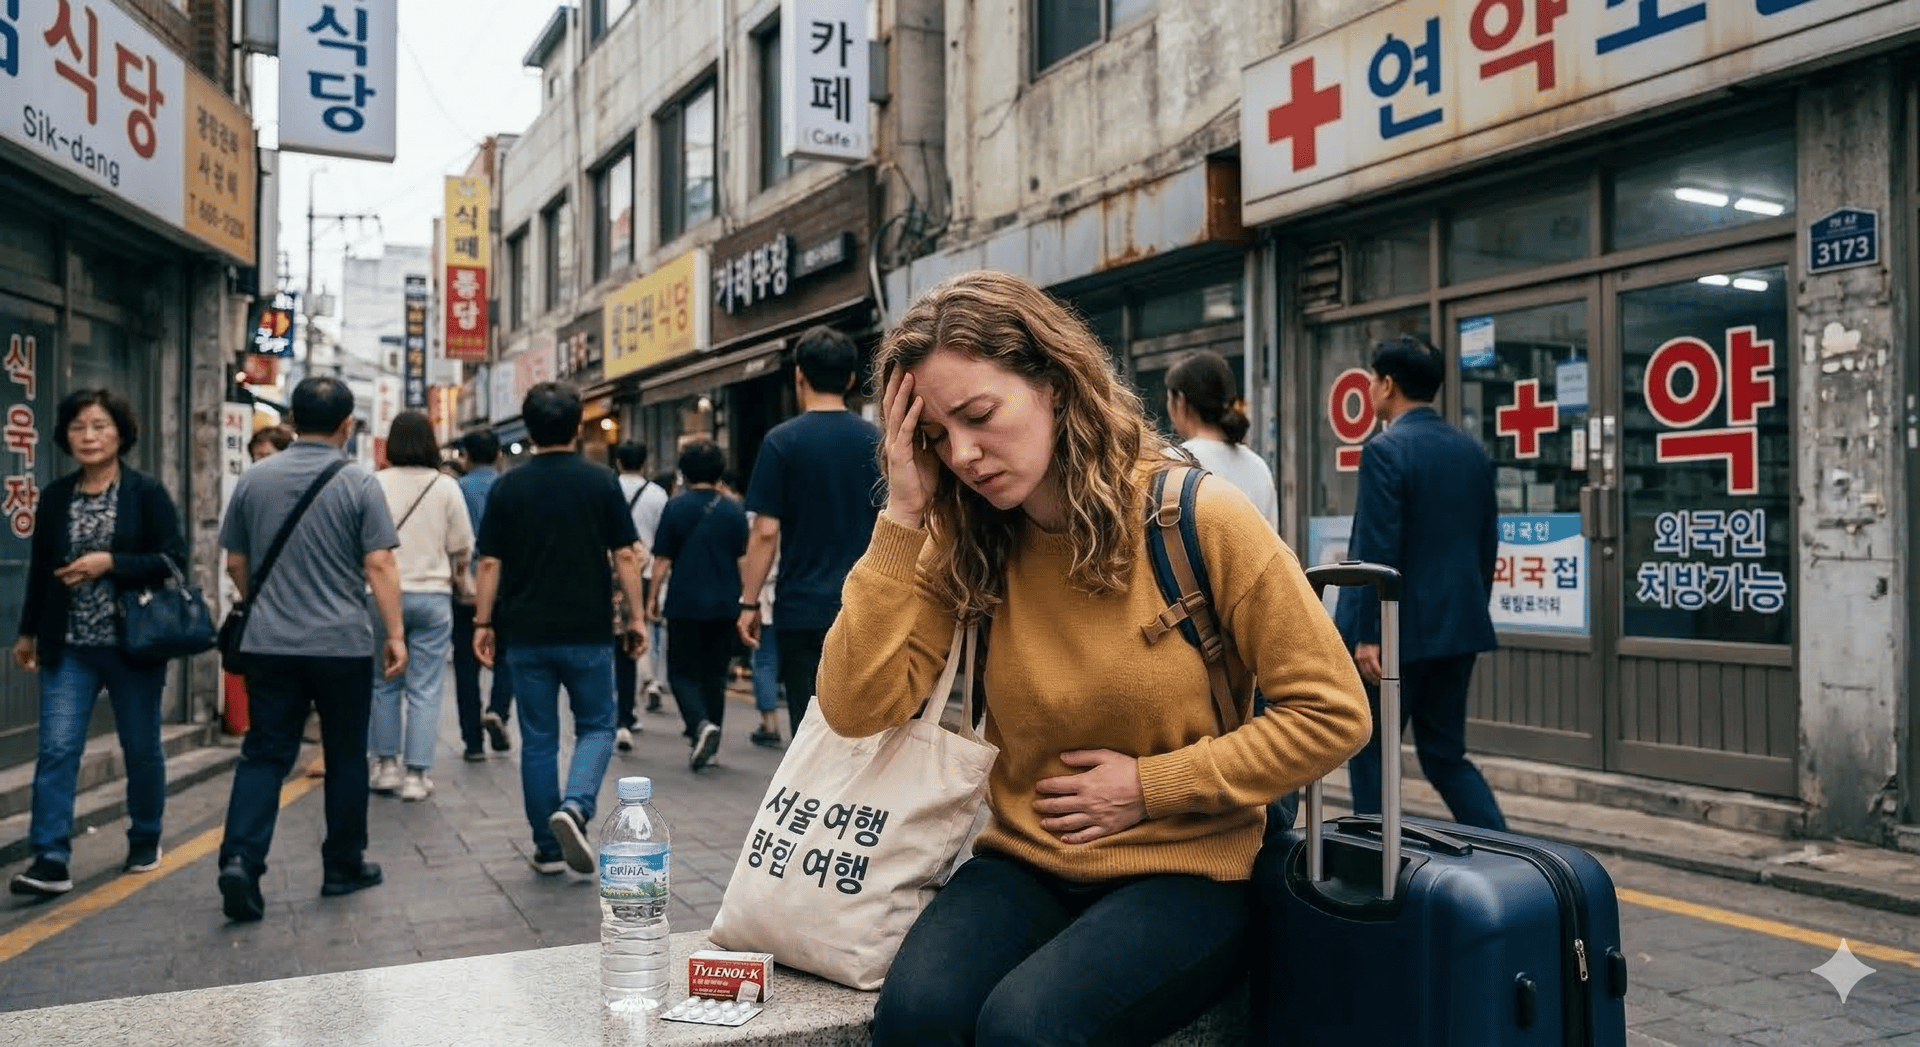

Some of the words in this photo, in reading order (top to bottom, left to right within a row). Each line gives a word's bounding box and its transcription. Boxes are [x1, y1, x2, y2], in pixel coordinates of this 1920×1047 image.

[307, 4, 376, 133] 식당
[811, 21, 853, 124] 카페
[23, 105, 120, 187] Sik-dang
[1817, 236, 1869, 265] 3173
[1643, 325, 1775, 495] 약
[1654, 508, 1767, 558] 외국인
[1636, 561, 1786, 613] 처방가능
[766, 786, 820, 836] 서울
[823, 803, 889, 847] 여행
[802, 848, 870, 895] 여행
